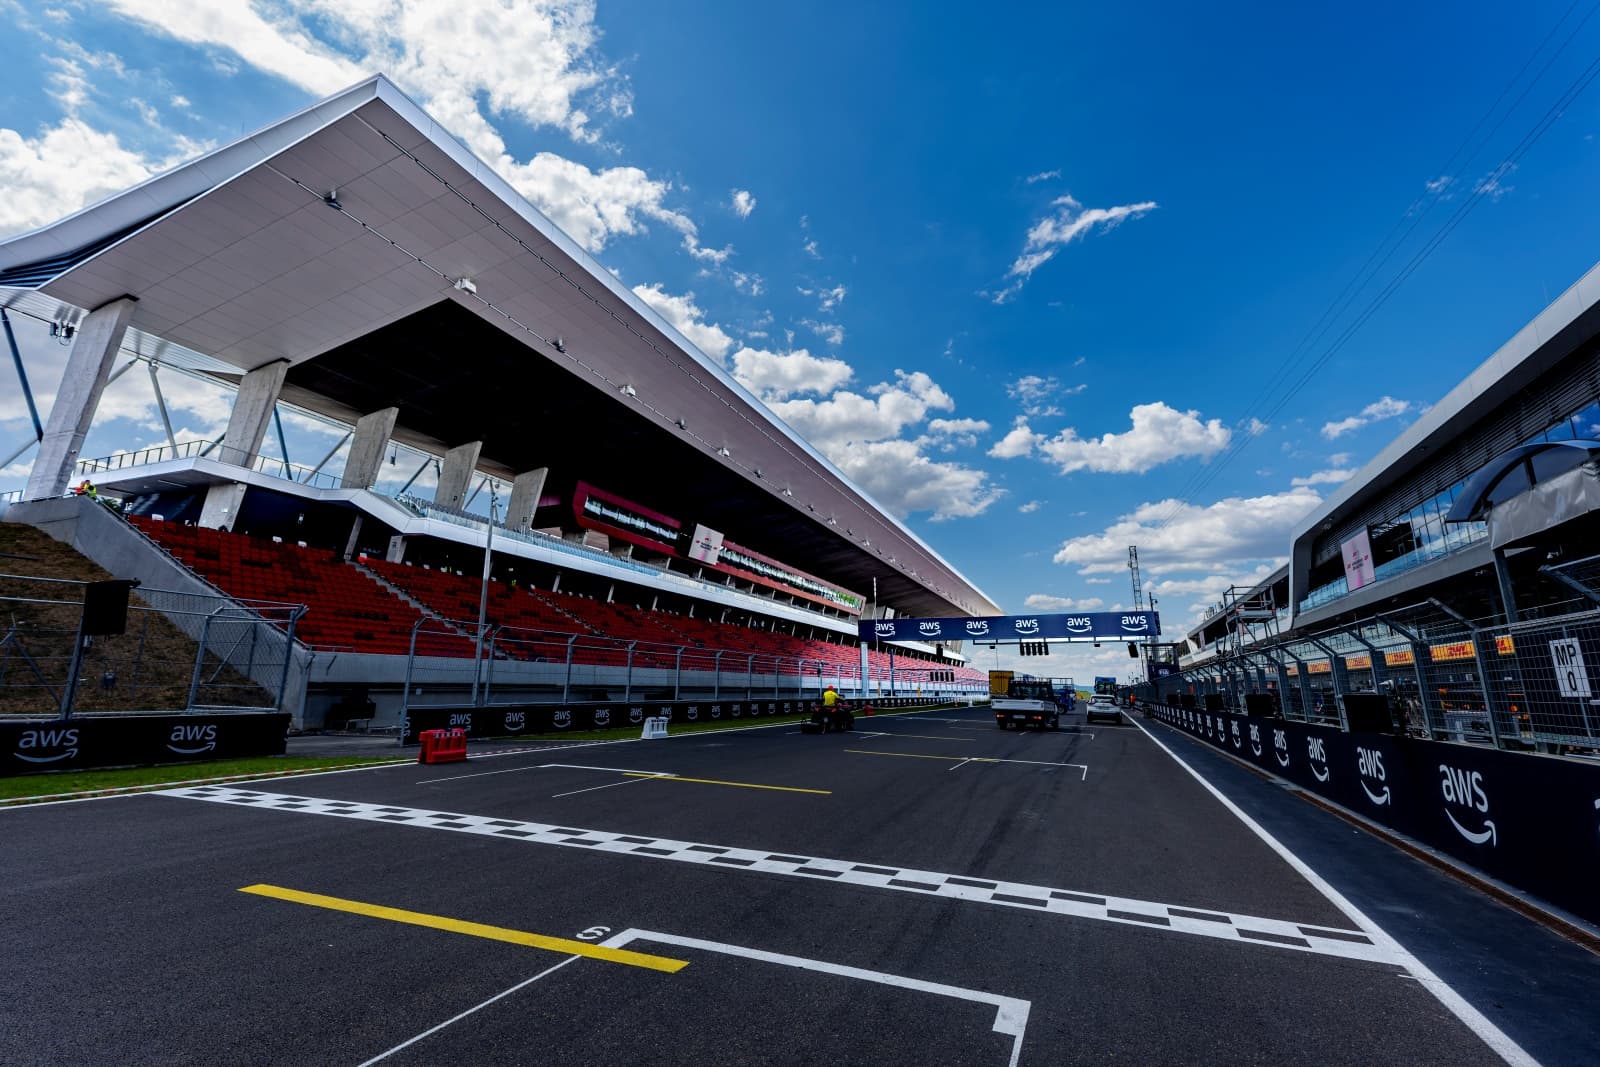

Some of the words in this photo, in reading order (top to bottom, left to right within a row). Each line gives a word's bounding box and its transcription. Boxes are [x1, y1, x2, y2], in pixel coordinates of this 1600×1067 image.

[1015, 619, 1038, 628] aws
[1067, 617, 1091, 626] aws
[1122, 615, 1147, 624] aws
[875, 622, 895, 631] aws
[920, 622, 940, 630] aws
[966, 620, 988, 629] aws
[1555, 644, 1576, 665] MP
[554, 711, 571, 720] aws
[596, 710, 610, 718] aws
[630, 708, 643, 716] aws
[660, 707, 672, 715] aws
[450, 714, 472, 724] aws
[506, 712, 525, 722] aws
[170, 724, 217, 742] aws
[18, 728, 79, 748] aws
[1273, 728, 1286, 750] aws
[1307, 736, 1326, 763] aws
[1357, 746, 1385, 782] aws
[1440, 764, 1488, 813] aws
